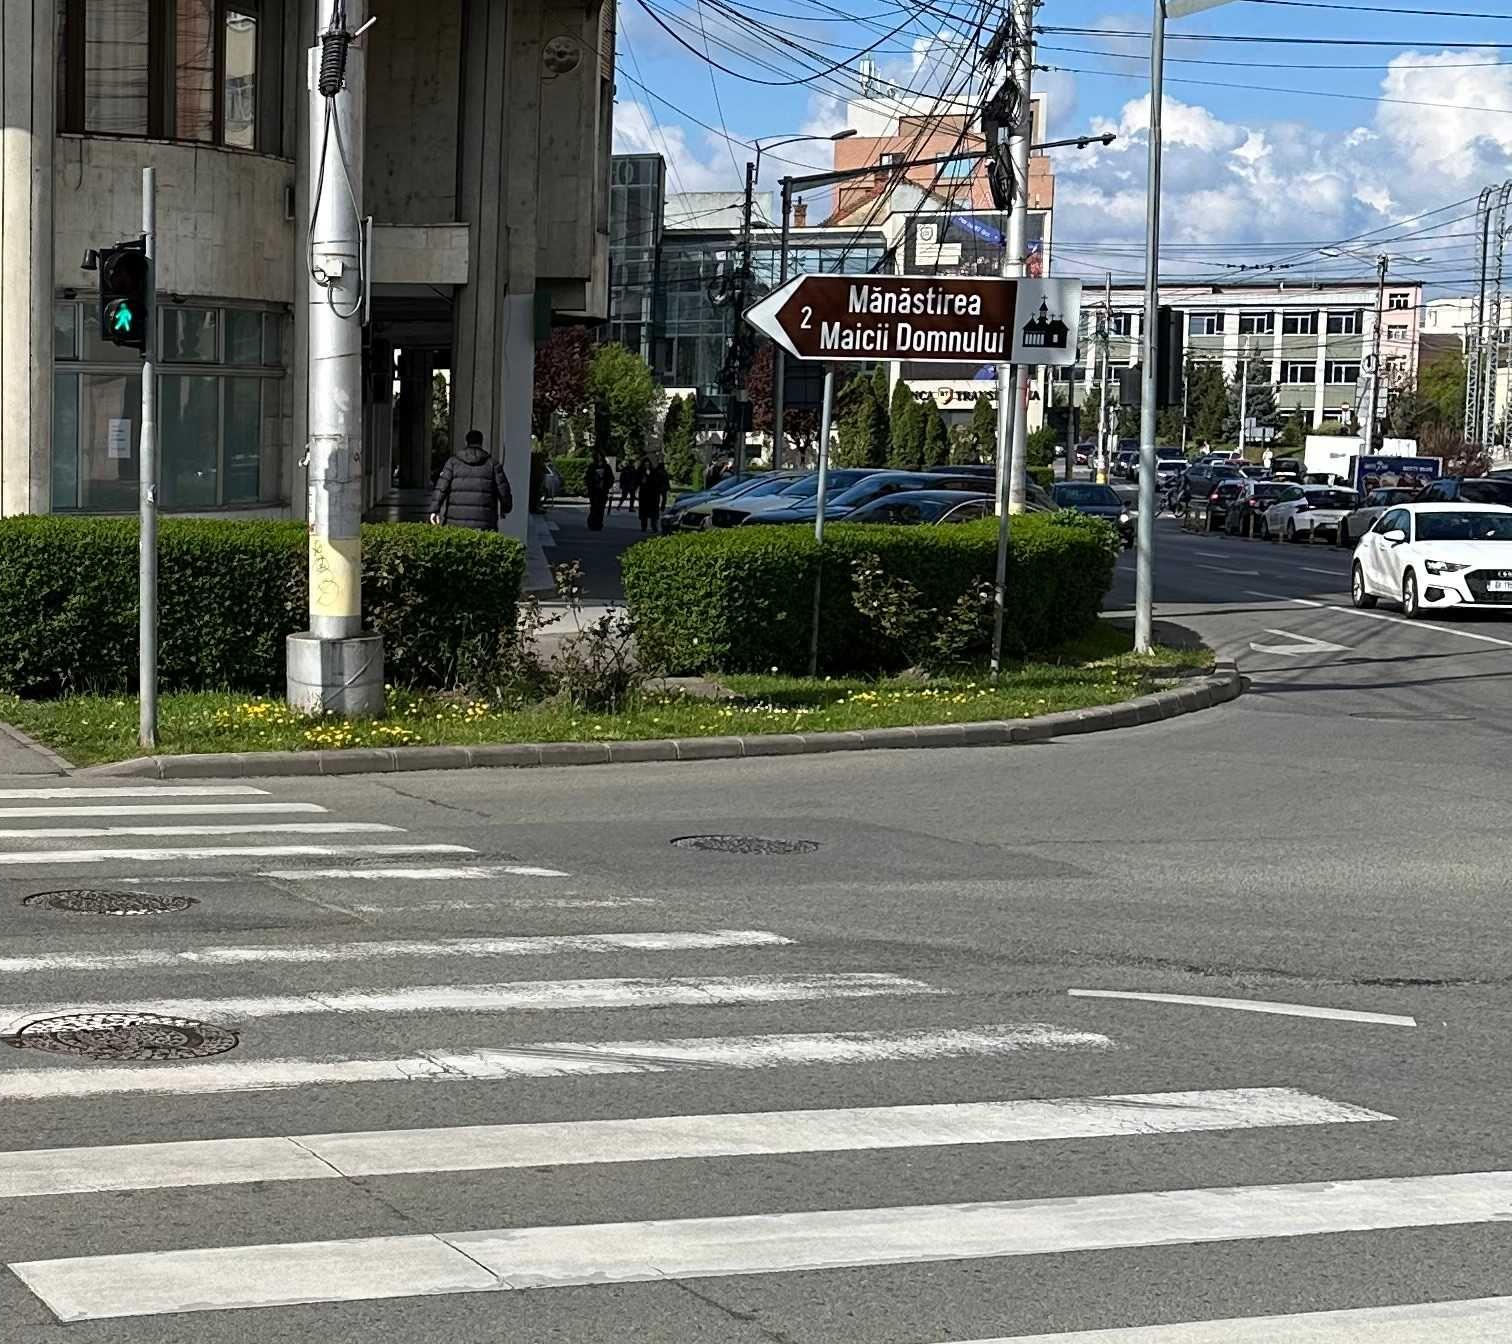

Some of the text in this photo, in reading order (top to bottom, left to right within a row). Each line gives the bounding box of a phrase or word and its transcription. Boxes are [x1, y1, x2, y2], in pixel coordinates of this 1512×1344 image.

[848, 284, 981, 316] Mănăstirea
[800, 306, 812, 329] 2
[820, 321, 1005, 354] Maicii Domnului
